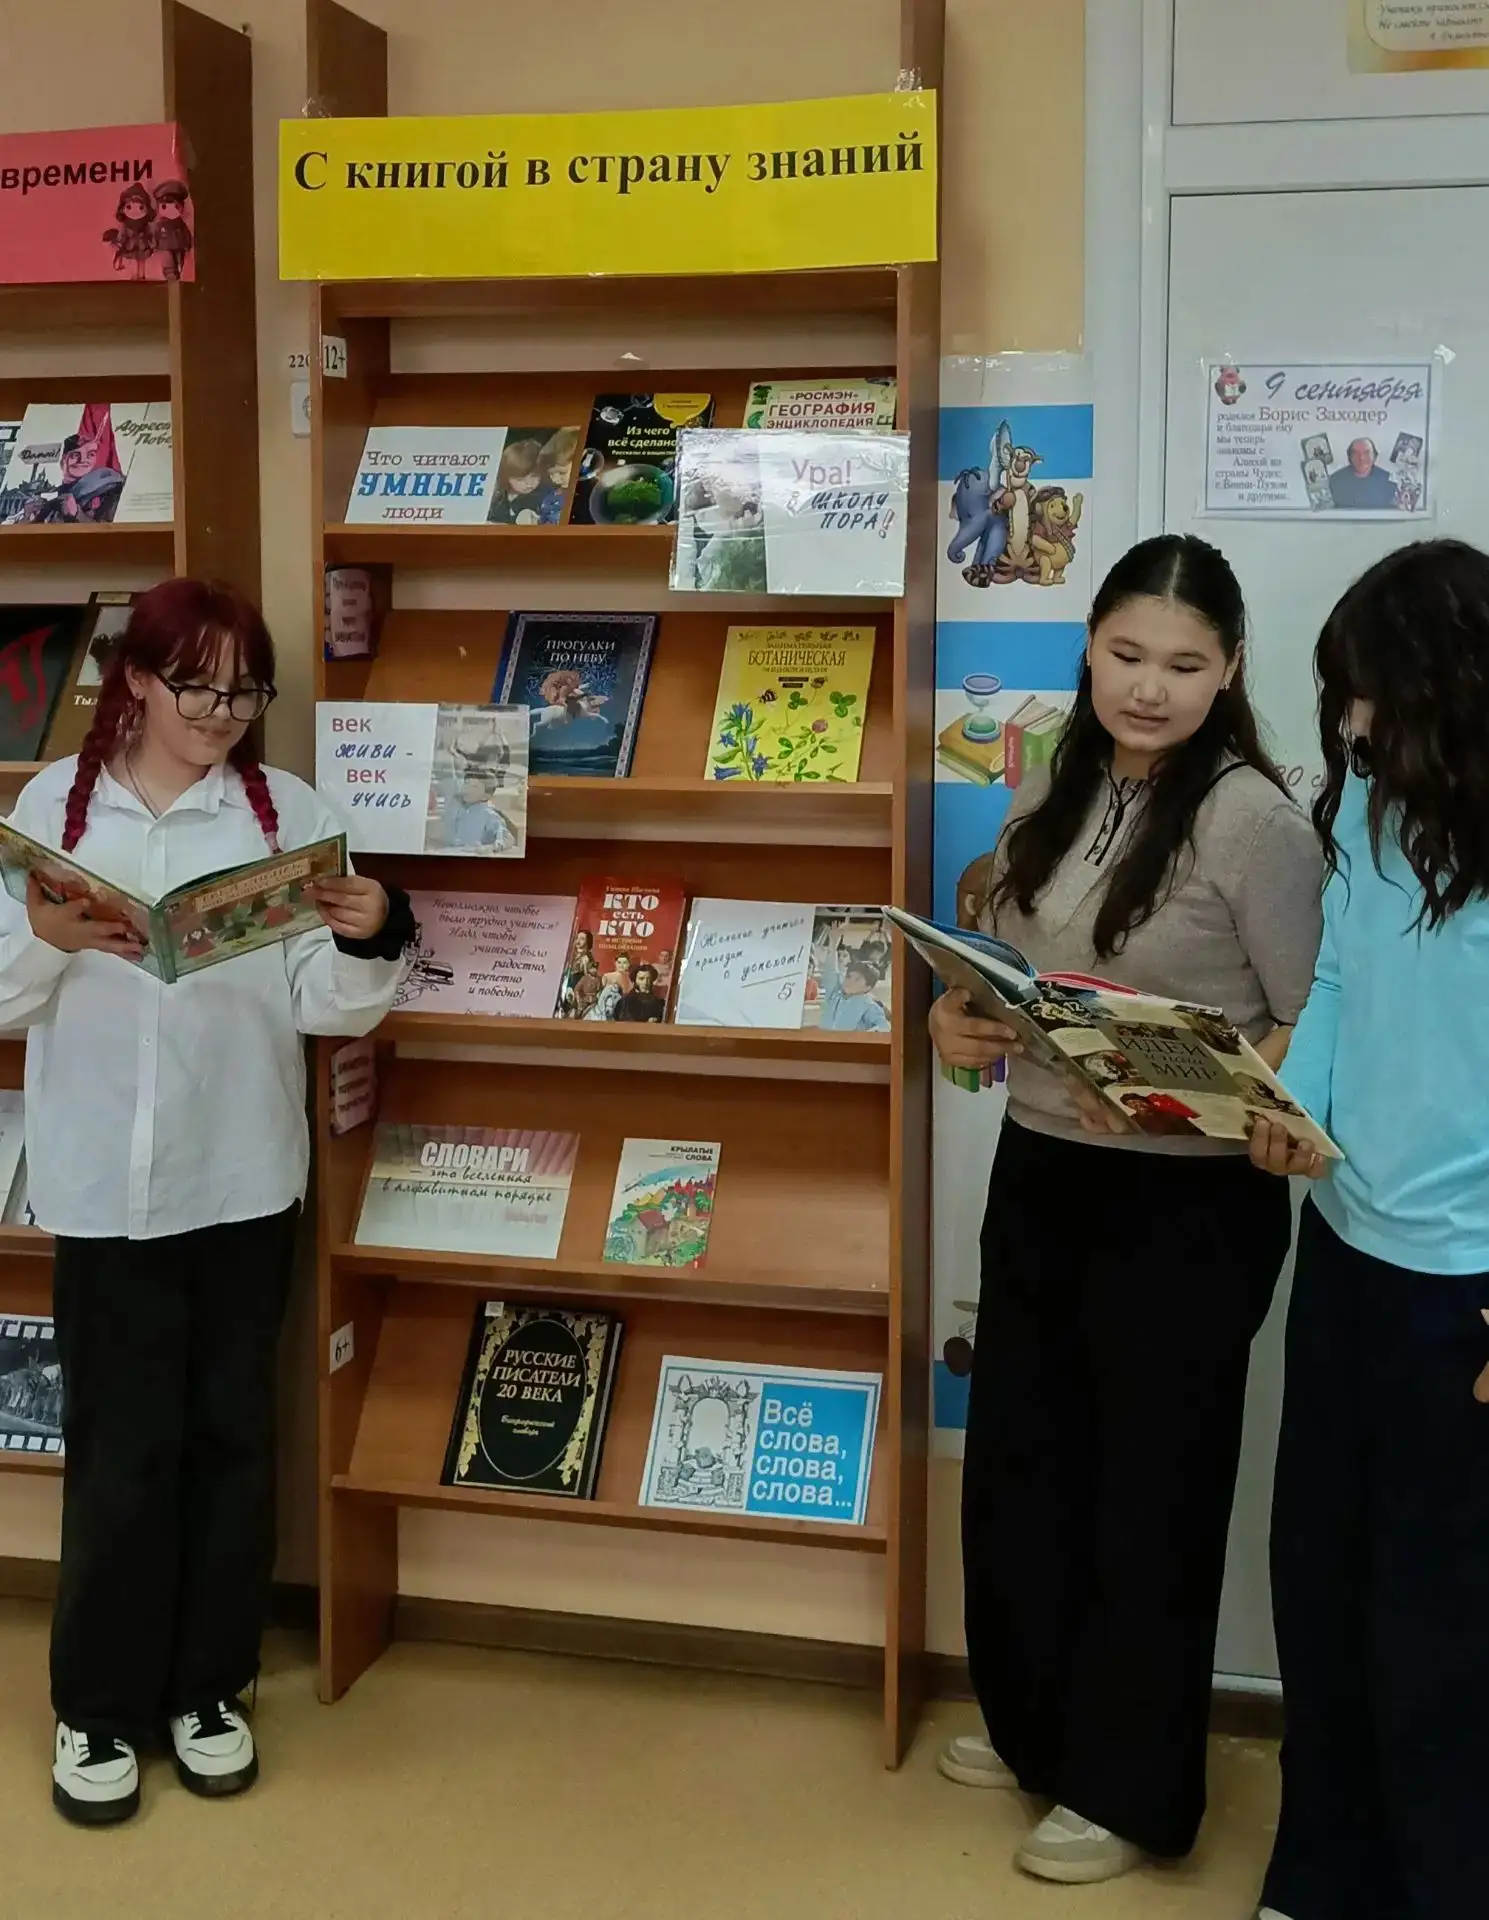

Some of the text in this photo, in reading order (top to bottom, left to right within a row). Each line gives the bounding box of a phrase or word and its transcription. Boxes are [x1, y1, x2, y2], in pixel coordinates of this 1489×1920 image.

[294, 130, 925, 195] С книгой в страну знаний
[1, 159, 153, 195] времени
[325, 345, 346, 369] 12+
[1265, 371, 1423, 407] 9 сентября
[768, 402, 876, 417] ГЕОГРАФИЯ
[1259, 406, 1310, 424] Борис
[1315, 406, 1388, 425] Заходер
[626, 426, 671, 437] Из чего
[766, 417, 874, 429] ЭНЦИКЛОПЕДИЯ
[607, 437, 628, 447] всё
[366, 450, 490, 466] Что читают
[791, 458, 853, 490] Ура!
[357, 472, 488, 497] УМНЫЕ
[382, 507, 444, 521] люди
[545, 640, 615, 651] ПРОГУЛКИ
[550, 652, 608, 663] ПО НЕБУ
[748, 650, 847, 666] БОТАНИЧЕСКАЯ
[332, 717, 373, 733] век
[346, 768, 388, 784] век
[432, 898, 540, 916] Невозможно, чтобы
[603, 893, 660, 911] КТО
[438, 911, 466, 923] было
[467, 915, 507, 929] трудно
[612, 911, 645, 920] есть
[448, 926, 517, 941] Надо, чтобы
[598, 919, 655, 937] КТО
[470, 943, 548, 957] учиться было
[491, 959, 546, 975] радостно,
[469, 971, 522, 985] трепетно
[468, 986, 526, 999] и победно!
[777, 981, 796, 1001] 5
[420, 1141, 530, 1173] СЛОВАРИ
[671, 1146, 714, 1155] КРЫЛАТЫЕ
[685, 1153, 713, 1162] СЛОВА
[430, 1168, 457, 1179] это
[462, 1167, 533, 1184] вселенная
[382, 1177, 553, 1205] в алфавитном порядке
[503, 1349, 577, 1369] РУССКИЕ
[492, 1365, 582, 1388] ПИСАТЕЛИ
[496, 1383, 563, 1404] 20 ВЕКА
[763, 1398, 814, 1427] Всё
[759, 1429, 848, 1460] слова,
[755, 1454, 844, 1485] слова,
[752, 1479, 852, 1508] слова...
